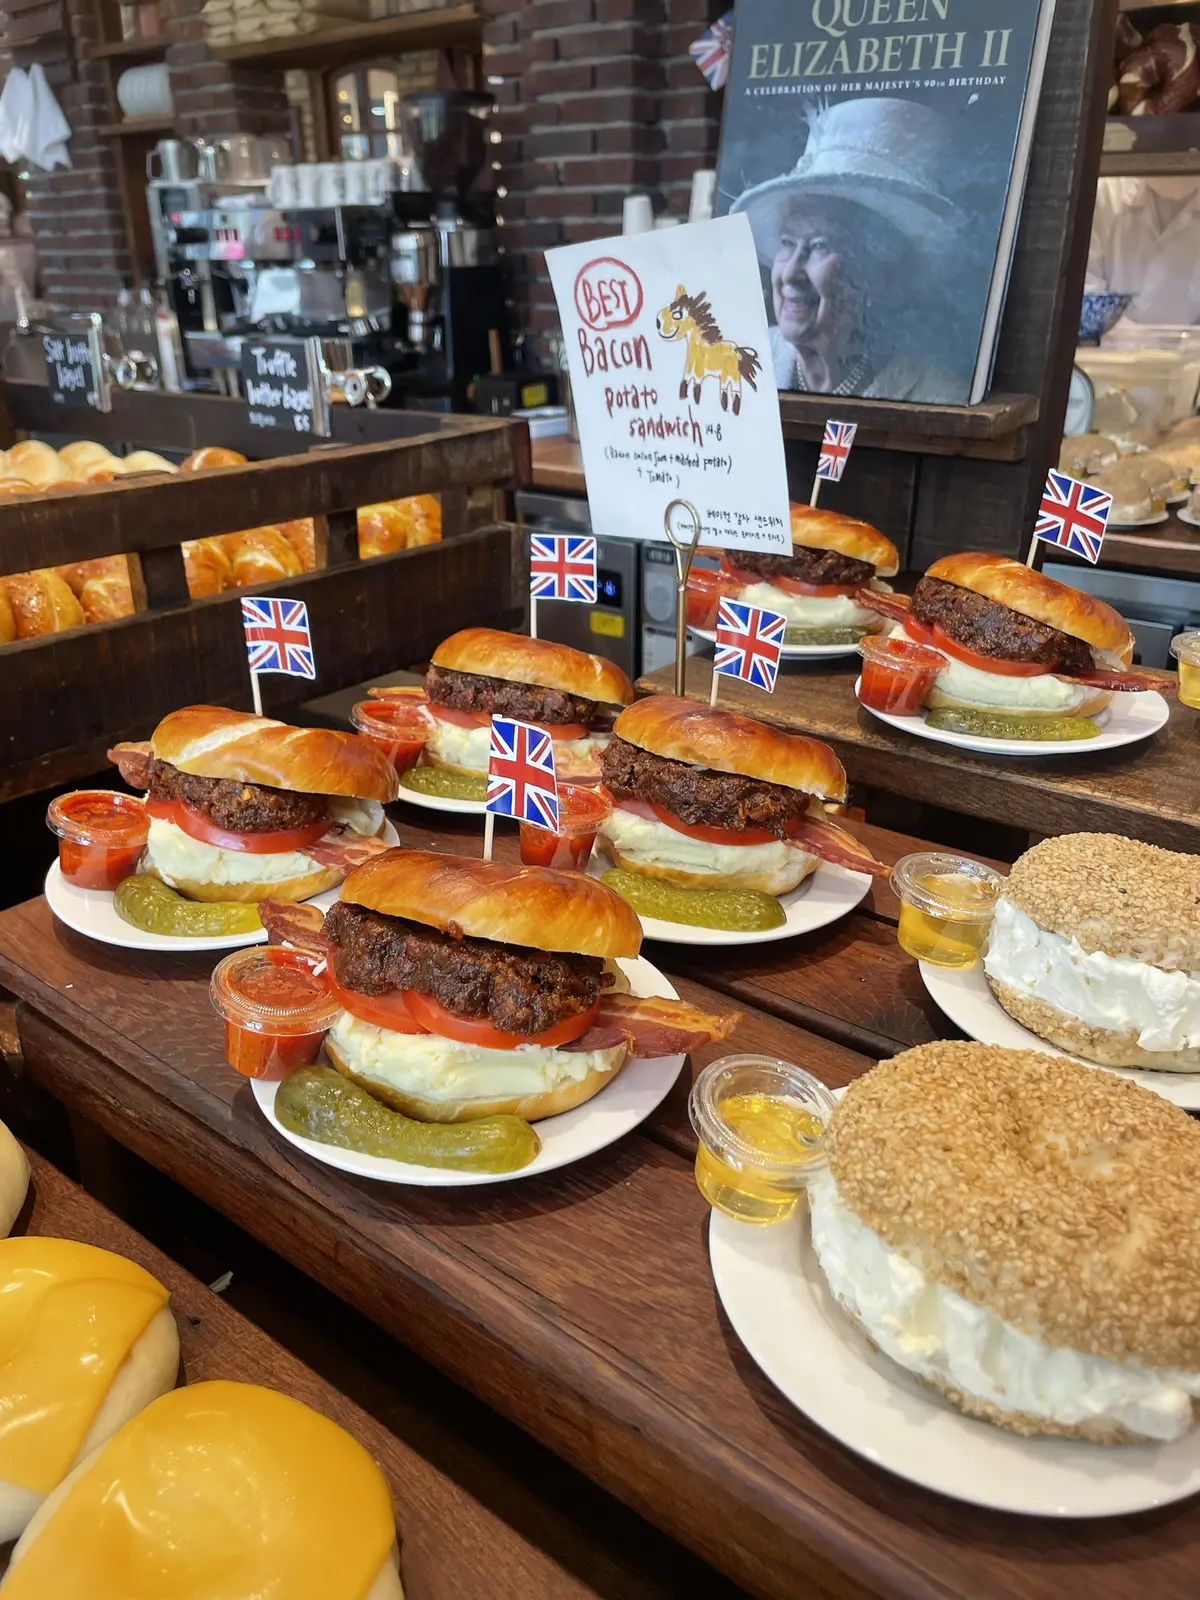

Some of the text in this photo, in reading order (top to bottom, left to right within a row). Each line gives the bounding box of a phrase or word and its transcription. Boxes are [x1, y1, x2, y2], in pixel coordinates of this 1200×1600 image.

[812, 0, 949, 38] QUEEN
[747, 28, 1013, 79] ELIZABETH II
[745, 87, 752, 96] A
[753, 83, 821, 96] CELEBRATION
[824, 82, 838, 92] OF
[841, 82, 861, 92] HER
[864, 79, 921, 92] MAJESTY'S
[948, 76, 1006, 87] BIRTHDAY
[582, 279, 632, 324] BEST
[577, 328, 652, 377] Bacon
[604, 384, 658, 419] potato
[629, 404, 704, 448] sandwich
[706, 509, 731, 523] 베이컨
